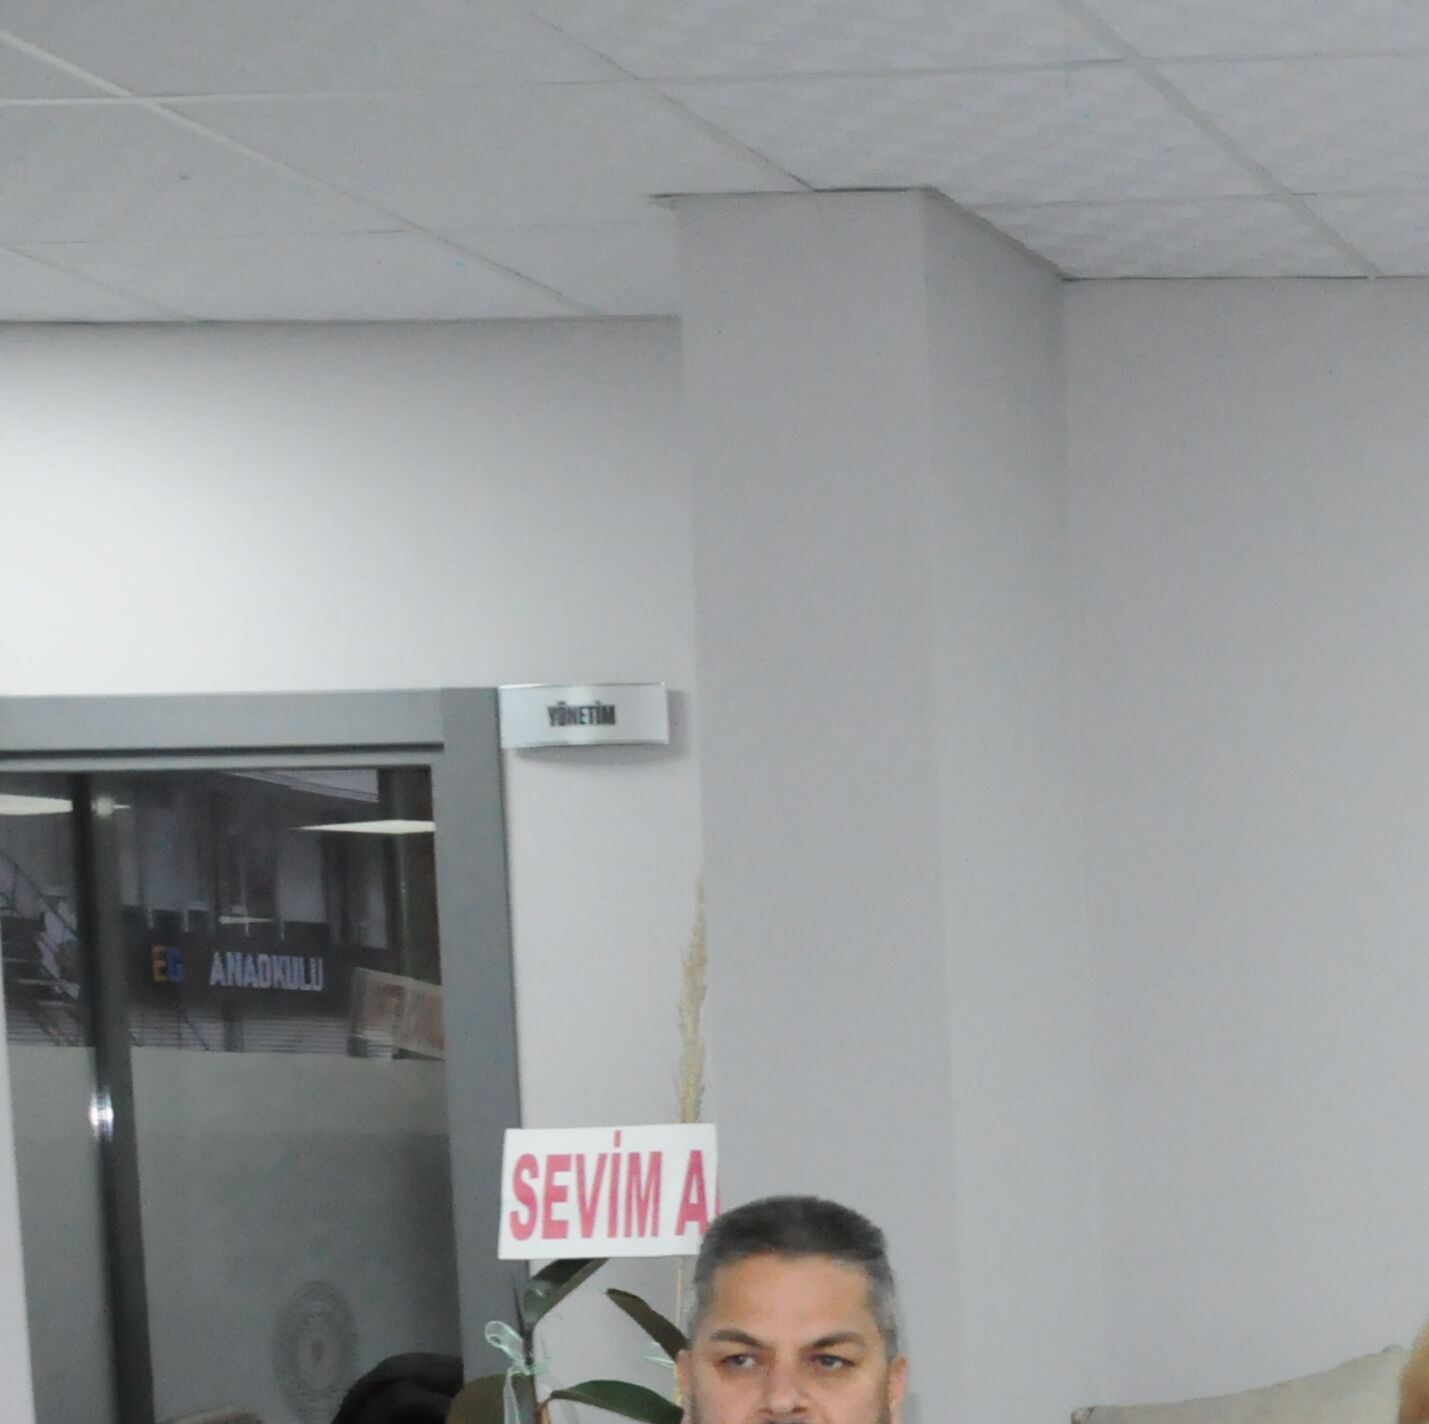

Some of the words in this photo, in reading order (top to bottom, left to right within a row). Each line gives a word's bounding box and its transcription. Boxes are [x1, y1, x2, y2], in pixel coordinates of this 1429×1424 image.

[547, 700, 616, 726] YÖNETİM
[208, 951, 325, 992] ANAOKULU
[509, 1129, 663, 1241] SEVİM
[674, 1149, 720, 1236] A
